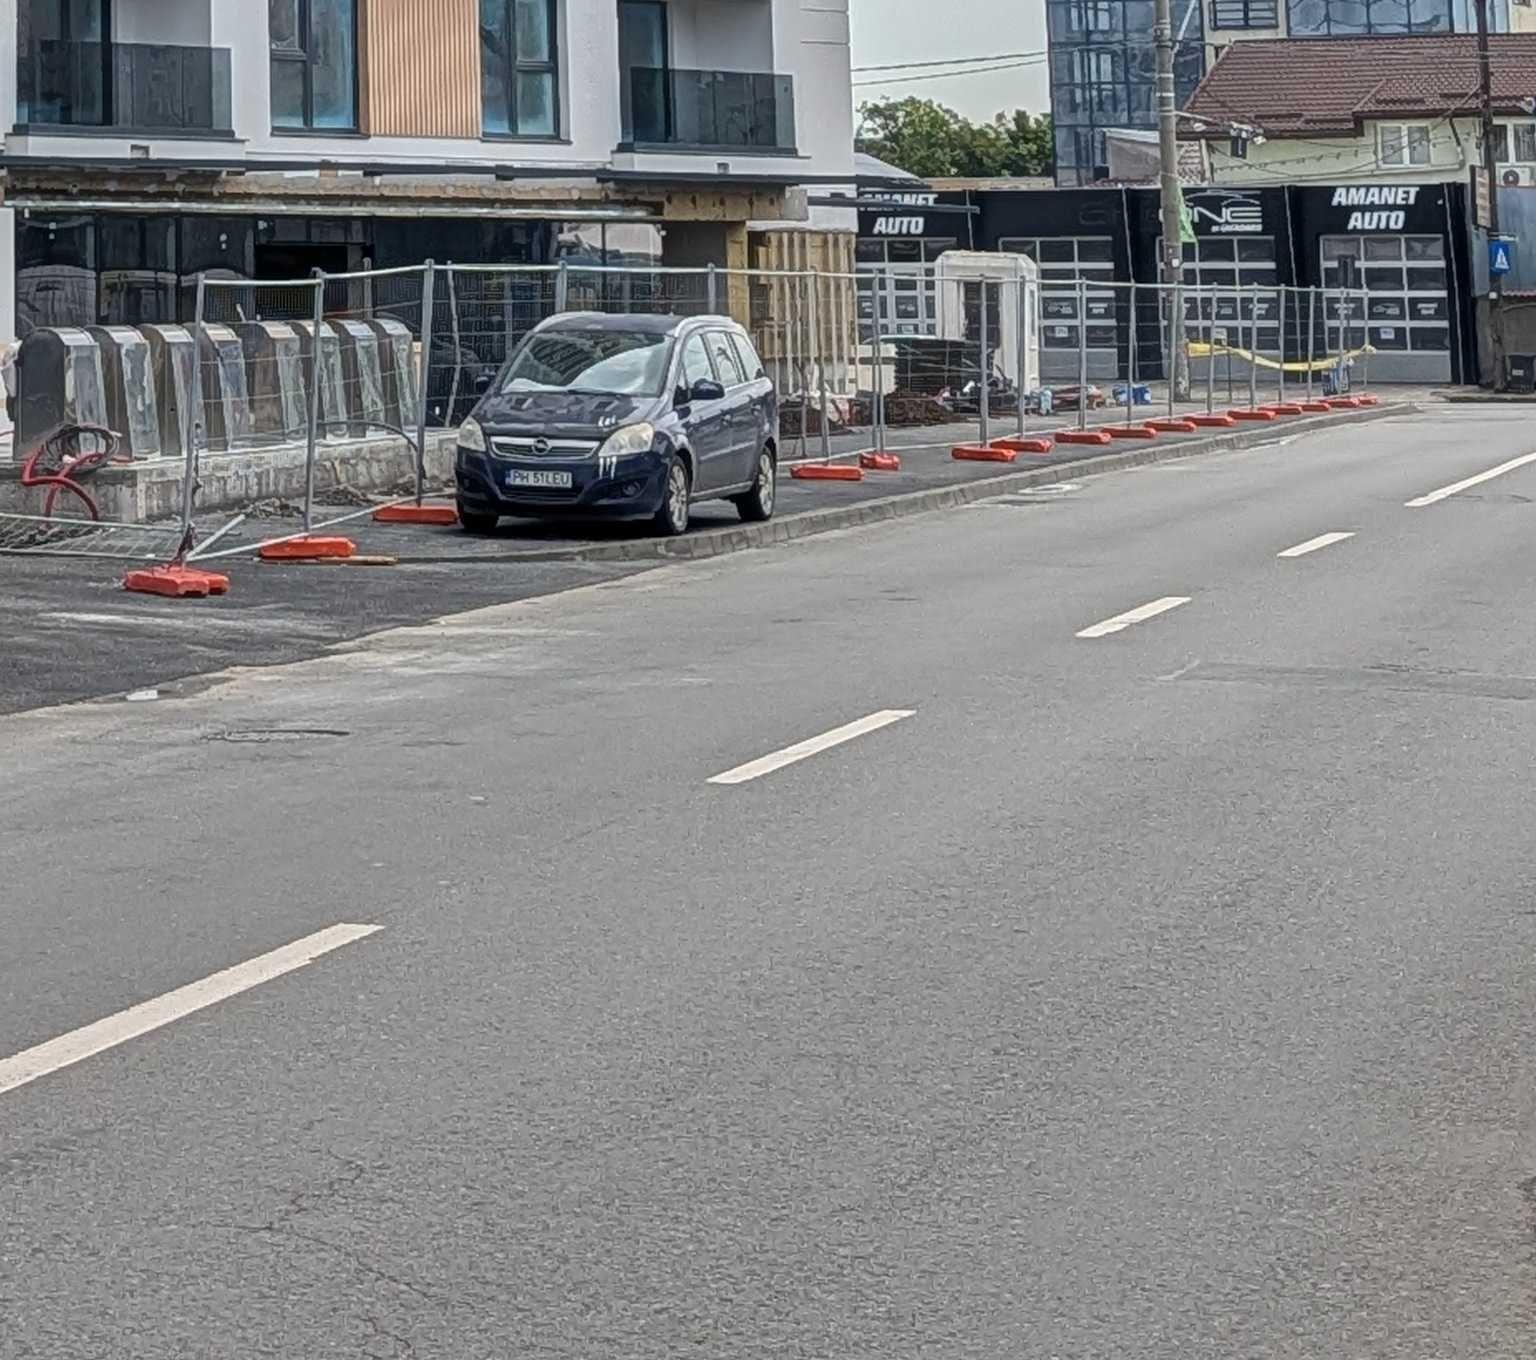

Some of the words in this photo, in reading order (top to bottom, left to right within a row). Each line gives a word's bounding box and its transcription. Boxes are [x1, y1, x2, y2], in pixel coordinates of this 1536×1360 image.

[1331, 186, 1420, 206] AMANET
[872, 216, 925, 235] AUTO
[1347, 210, 1405, 230] AUTO
